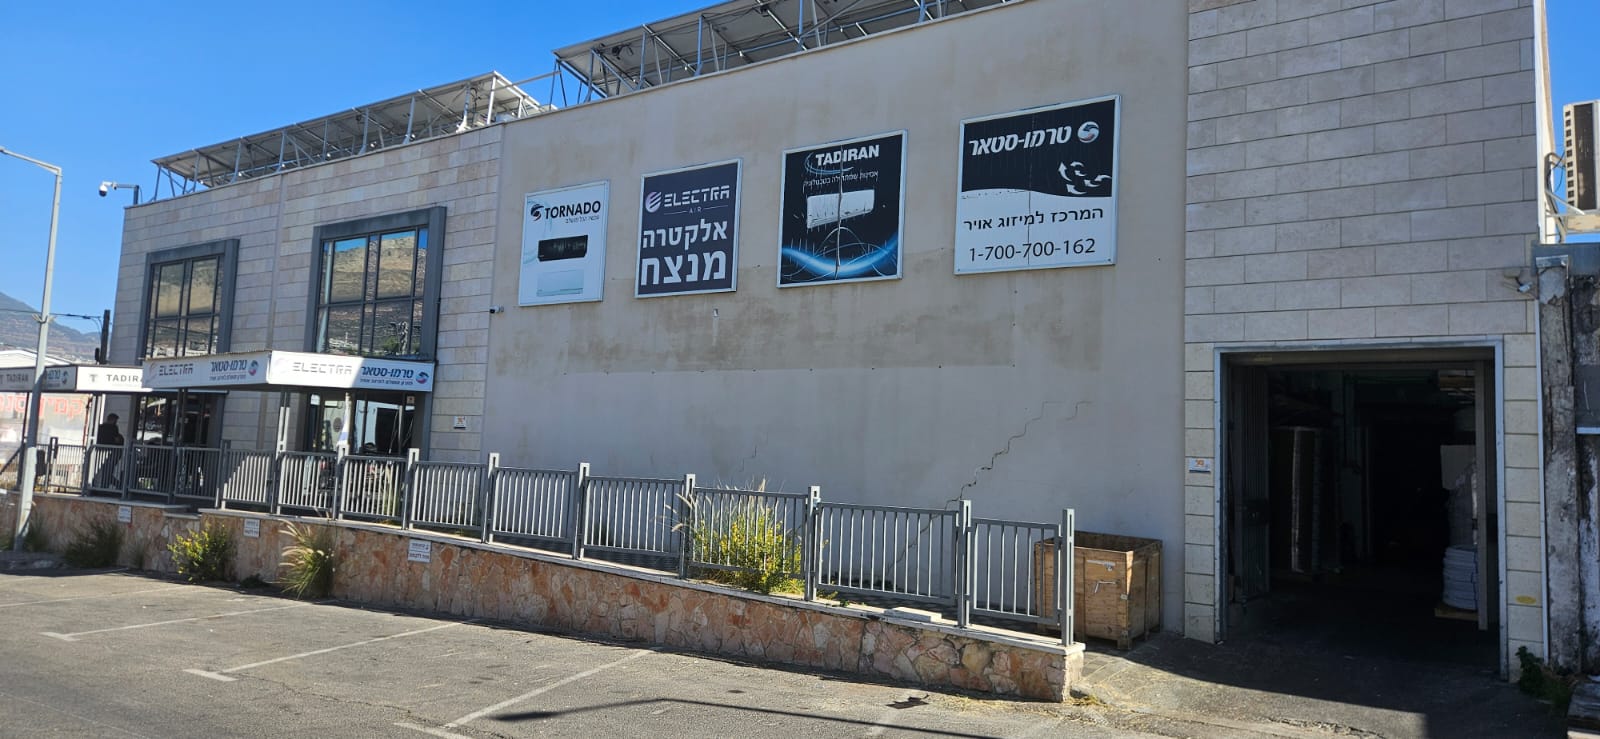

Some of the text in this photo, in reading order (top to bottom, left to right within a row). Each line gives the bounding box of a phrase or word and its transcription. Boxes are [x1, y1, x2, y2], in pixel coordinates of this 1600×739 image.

[969, 125, 1072, 156] טרמו-סטאר
[815, 144, 879, 166] TADIRAN
[664, 185, 730, 207] ELECTRA
[545, 200, 601, 219] TORNADO
[963, 207, 1103, 231] המרכז למיזוג אויר
[642, 218, 728, 250] אלקטרה
[969, 238, 1096, 262] 1-700-700-162
[640, 250, 727, 286] מנצח
[106, 374, 142, 383] TADIR
[159, 363, 193, 376] ELECTRA
[292, 361, 353, 374] ELECTRA
[361, 366, 414, 379] טרמו-סטאר
